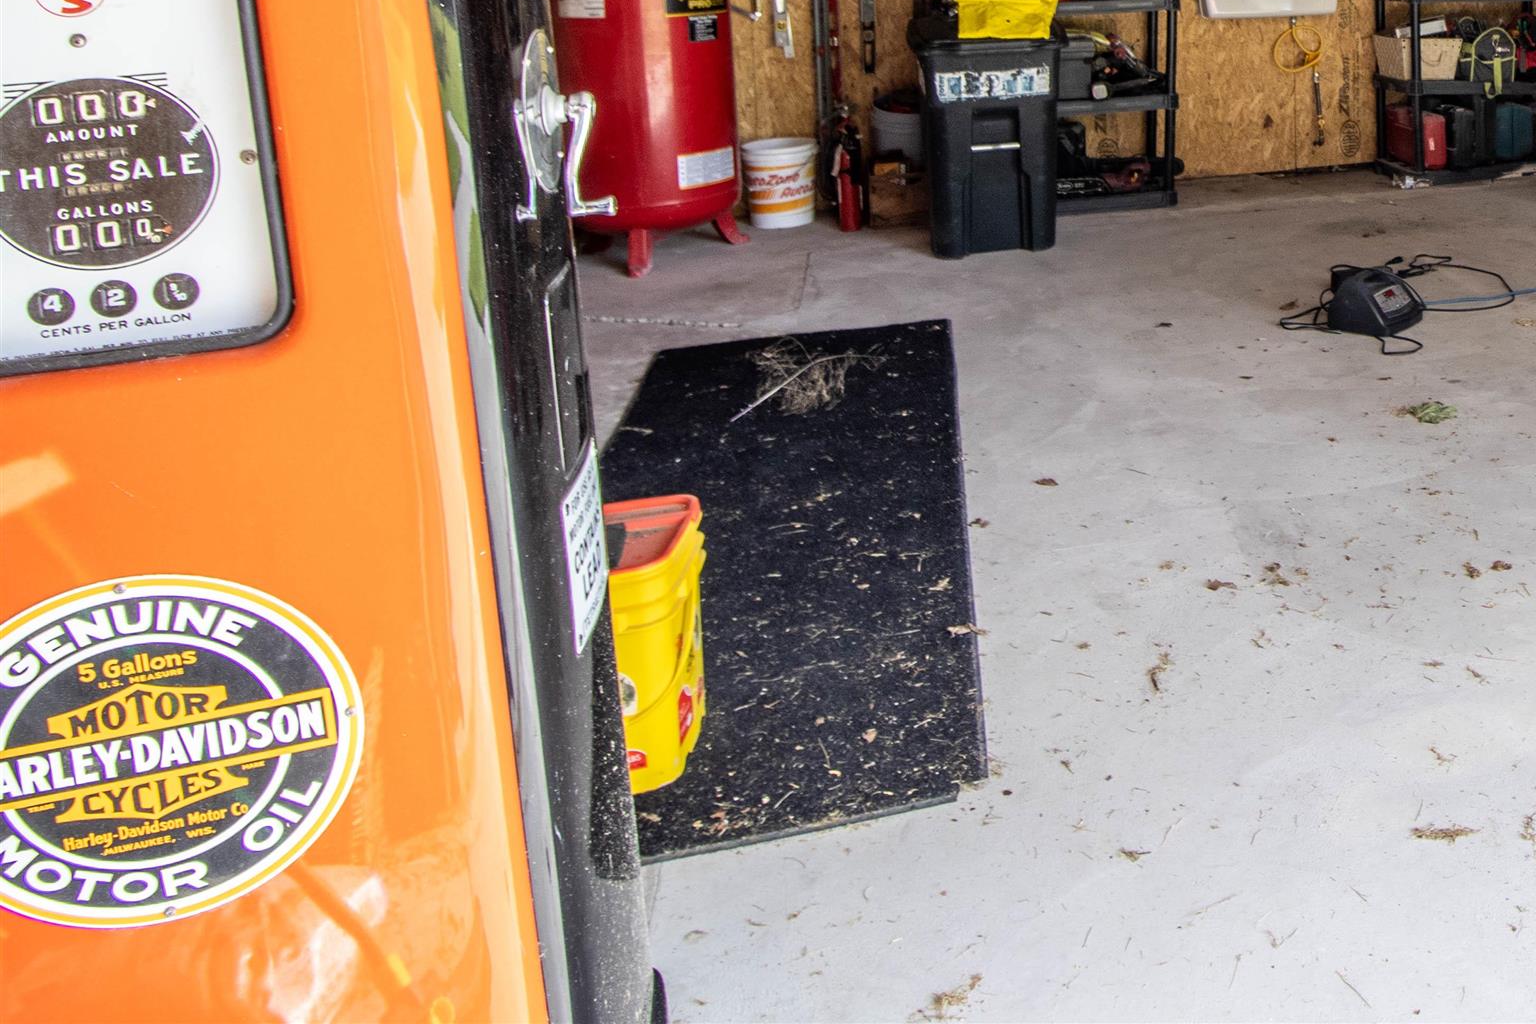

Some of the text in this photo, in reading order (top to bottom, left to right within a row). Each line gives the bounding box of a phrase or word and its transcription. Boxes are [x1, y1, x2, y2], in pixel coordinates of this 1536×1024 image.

[46, 125, 138, 143] AMOUNT
[0, 153, 203, 193] THIS SALE
[57, 200, 153, 220] GALLONS
[43, 295, 63, 312] 4
[107, 289, 127, 307] 2
[40, 312, 192, 338] CENTS PER GALLON
[0, 600, 258, 688] GENUINE
[77, 650, 197, 683] 5 Gallons
[98, 668, 184, 689] U.S. MEASURE
[69, 689, 210, 738] MOTOR
[82, 768, 222, 814] CYCLES
[0, 780, 322, 903] MOTOR OIL
[63, 816, 184, 852] Harley-Davidson
[187, 807, 228, 827] Motor
[186, 826, 216, 840] WIS.
